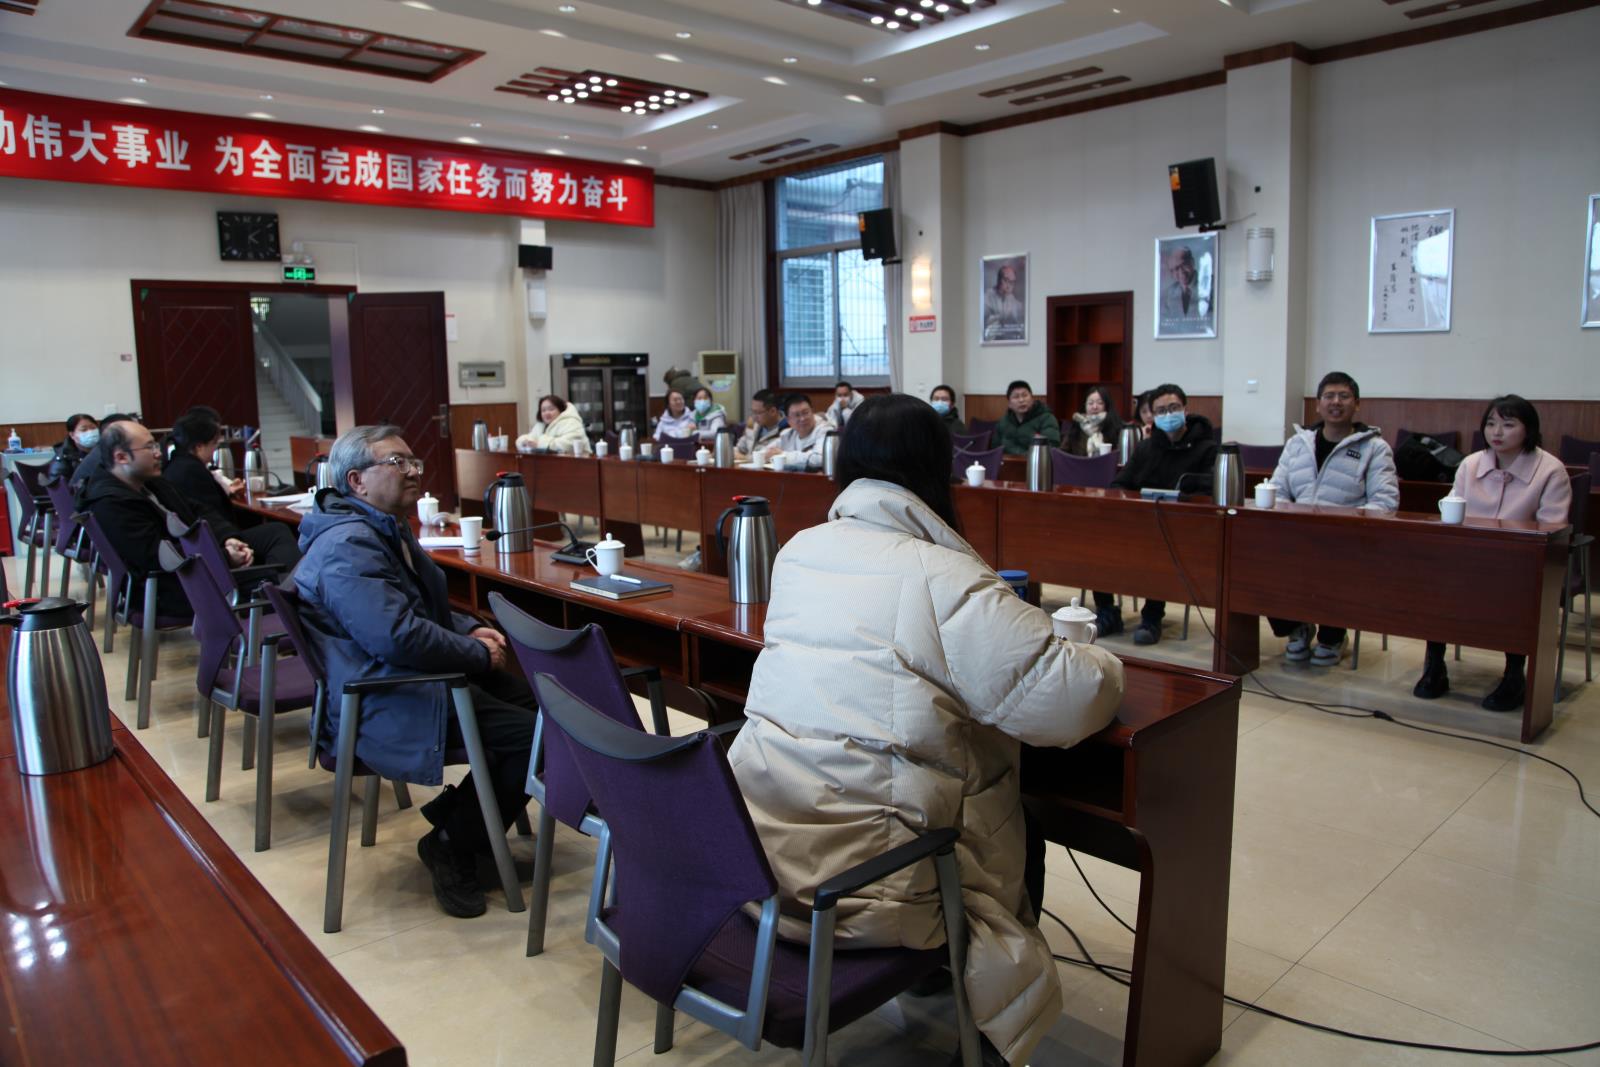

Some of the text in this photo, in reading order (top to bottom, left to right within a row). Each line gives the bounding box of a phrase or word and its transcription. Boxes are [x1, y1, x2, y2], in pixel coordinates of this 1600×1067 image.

[214, 136, 628, 211] 为全面完成国家任务而努力奋斗
